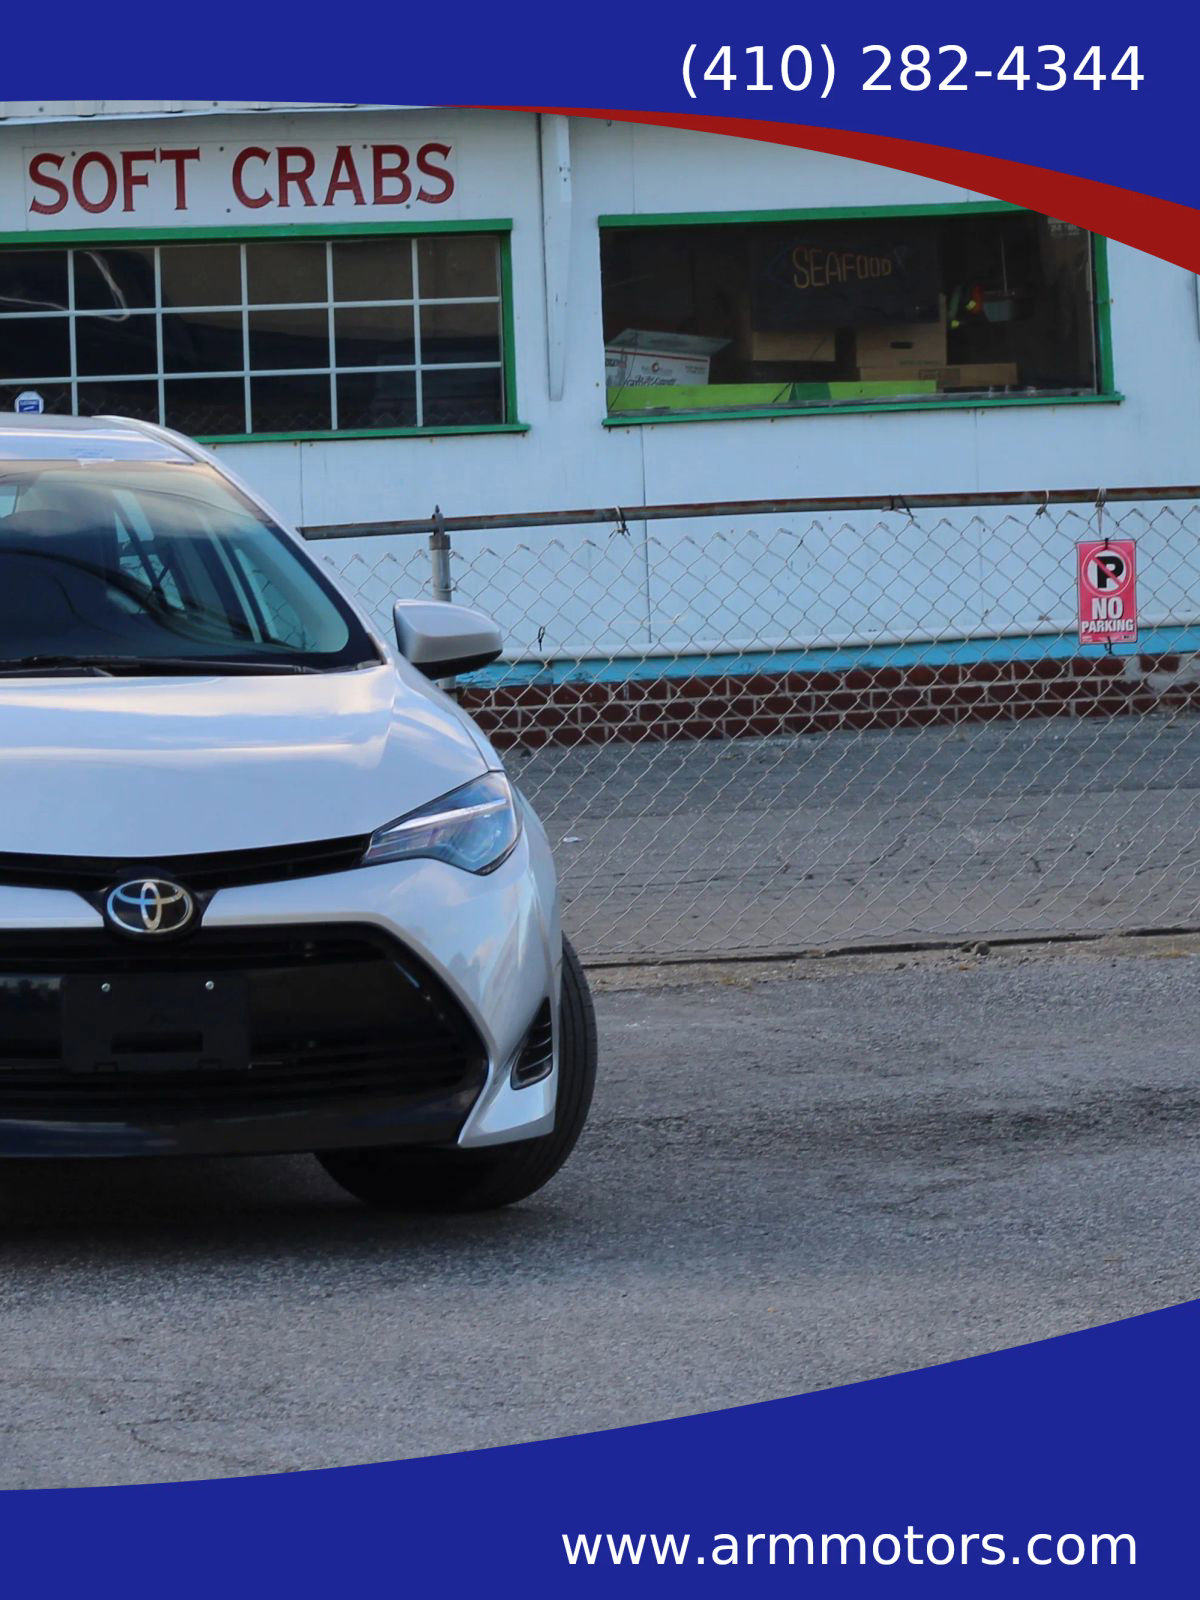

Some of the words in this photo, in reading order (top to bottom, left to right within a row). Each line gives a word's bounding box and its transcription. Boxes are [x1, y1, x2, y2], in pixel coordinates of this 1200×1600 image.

[28, 147, 201, 215] SOFT
[231, 142, 455, 208] CRABS
[792, 245, 892, 289] SEAFOOD
[1091, 597, 1123, 620] NO
[1081, 619, 1135, 633] PARKING
